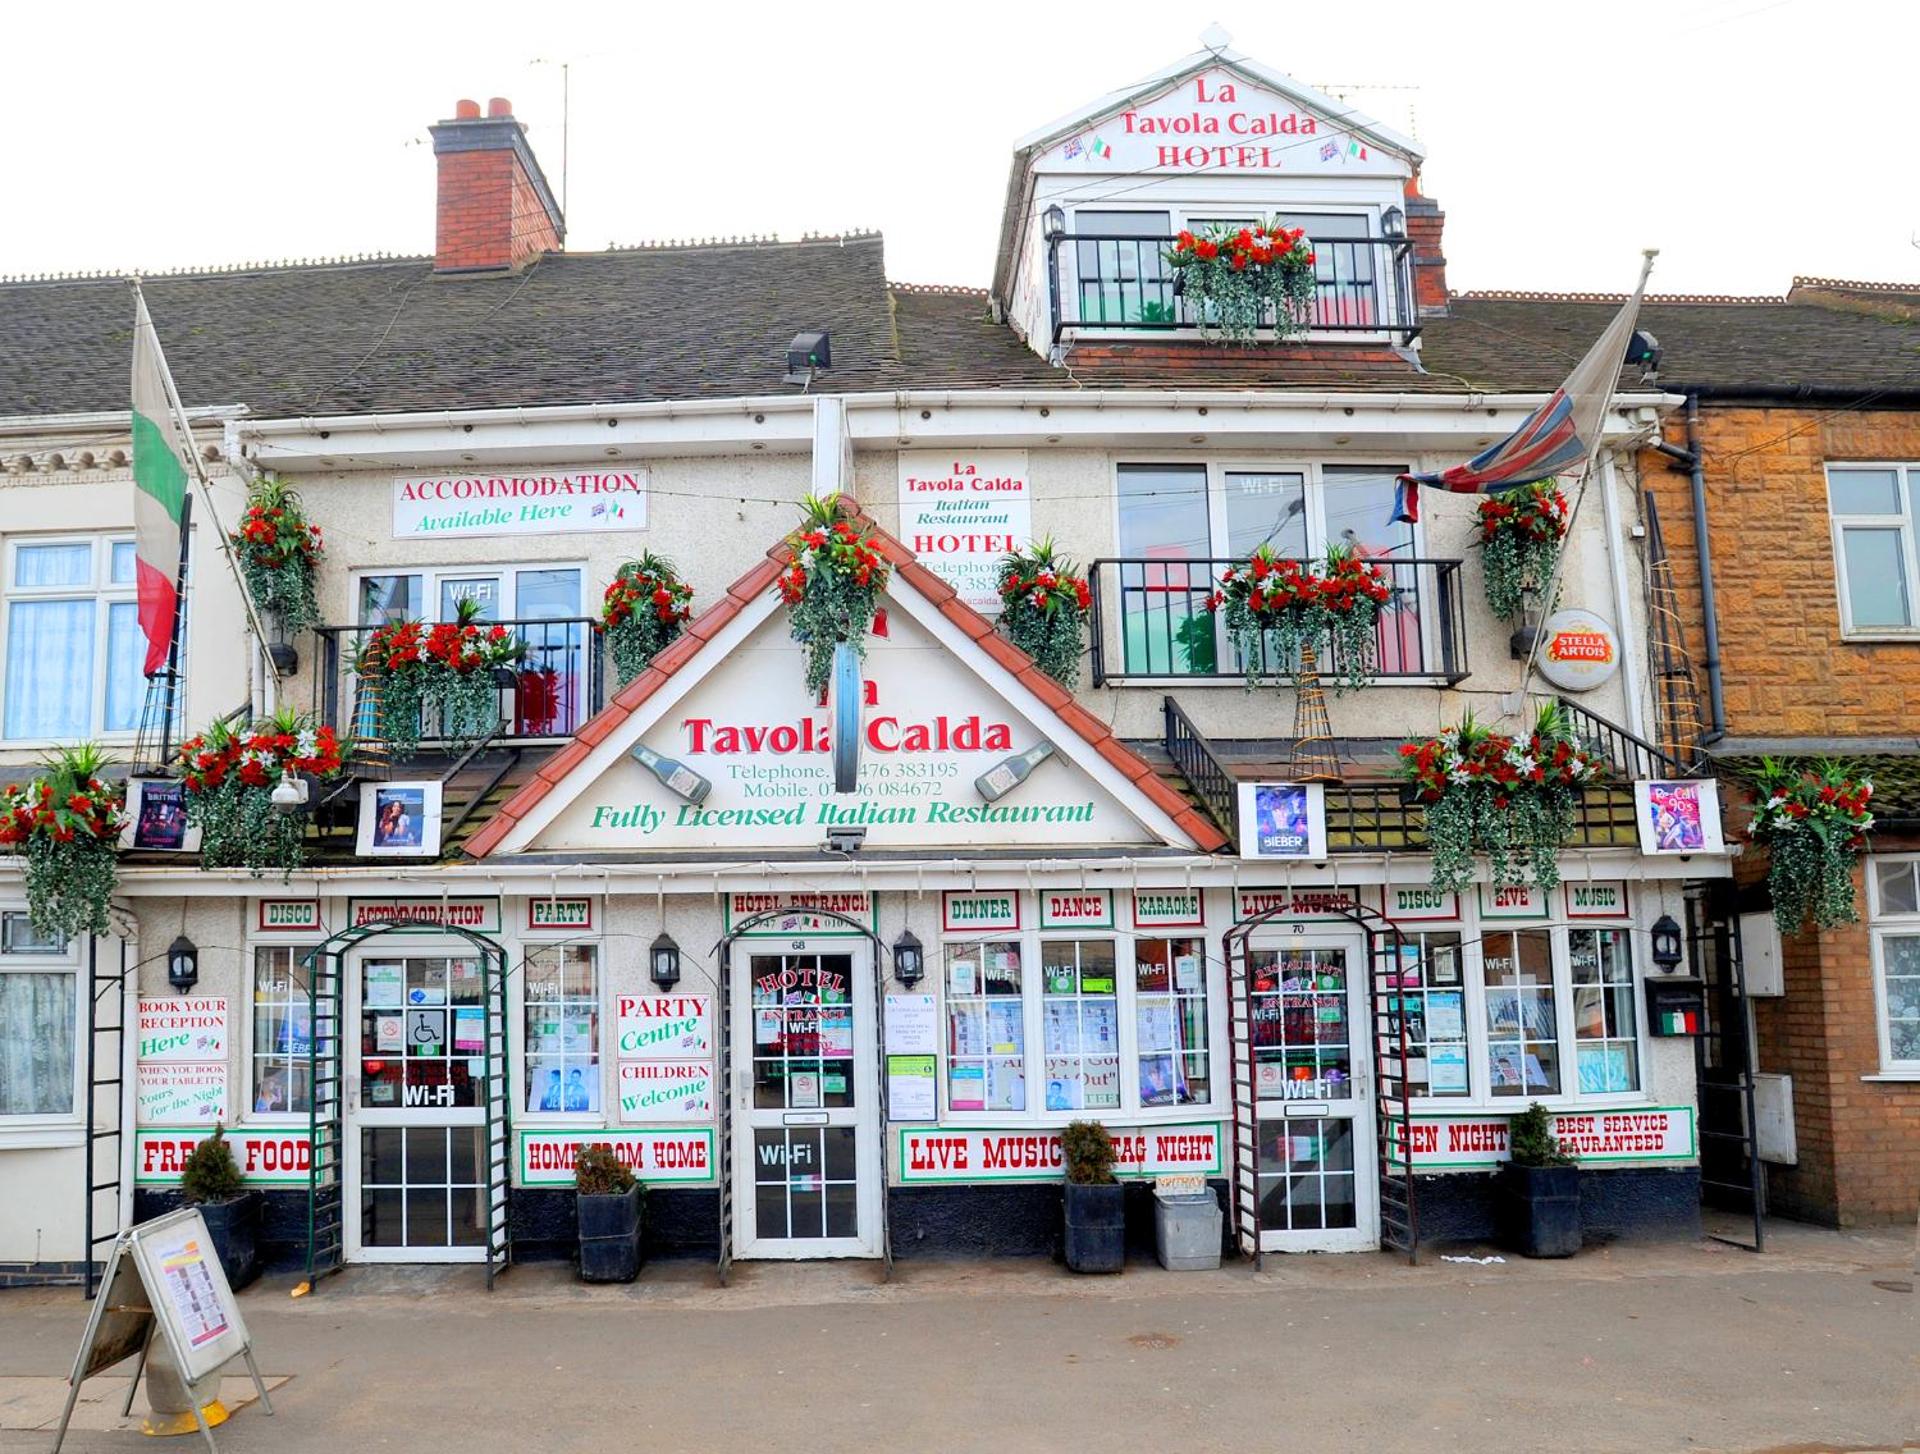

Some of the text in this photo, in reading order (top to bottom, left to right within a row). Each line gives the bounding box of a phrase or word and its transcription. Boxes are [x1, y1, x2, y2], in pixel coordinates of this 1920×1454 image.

[1196, 79, 1236, 103] La
[1120, 112, 1316, 135] Tavola Calda
[1157, 146, 1281, 168] HOTEL
[953, 462, 976, 475] La
[401, 474, 639, 501] ACCOMMODATION
[907, 478, 1022, 491] Tavola Calda
[936, 499, 990, 512] Italian
[415, 503, 573, 532] Available Here
[917, 514, 1008, 525] Restaurant
[914, 535, 1022, 553] HOTEL
[449, 583, 492, 601] Wi-Fi
[1560, 637, 1605, 647] STELLA
[1560, 647, 1605, 657] ARTOIS
[867, 715, 1010, 751] Calda
[728, 764, 830, 783] Telephone.
[895, 762, 959, 778] 383195
[744, 781, 813, 798] Mobile.
[879, 780, 942, 796] 084672
[593, 799, 1092, 832] Fully Licensed Italian Restaurant
[1264, 836, 1303, 847] BIEBER
[735, 895, 783, 912] HOTEL
[1138, 895, 1198, 914] KARAOKE
[1241, 894, 1283, 915] LIVE
[1397, 891, 1440, 910] DISCO
[1575, 886, 1616, 906] MUSIC
[270, 904, 313, 924] DISCO
[535, 903, 588, 921] PARTY
[951, 899, 1010, 917] DINNER
[1051, 896, 1102, 916] DANCE
[1293, 924, 1305, 934] 70
[792, 942, 806, 951] 68
[1485, 957, 1513, 971] Wi-Fi
[1571, 954, 1598, 967] Wi-Fi
[986, 969, 1015, 981] Wi-Fi
[1044, 966, 1075, 978] Wi-Fi
[1138, 964, 1166, 976] Wi-Fi
[259, 980, 288, 993] Wi-Fi
[529, 982, 559, 995] Wi-Fi
[758, 967, 846, 995] HOTEL
[139, 999, 226, 1014] BOOK YOUR
[620, 998, 707, 1017] PARTY
[1262, 996, 1340, 1009] ENTRANCE
[140, 1016, 224, 1030] RECEPTION
[762, 1009, 845, 1023] ENTRANCE
[1252, 1008, 1280, 1020] Wi-Fi
[619, 1017, 698, 1053] Centre
[789, 1021, 820, 1034] Wi-Fi
[140, 1033, 191, 1058] Here
[138, 1065, 225, 1075] WHEN YOU BOOK
[622, 1065, 709, 1080] CHILDREN
[403, 1084, 456, 1106] Wi-Fi
[620, 1081, 706, 1113] Welcome
[1283, 1079, 1331, 1100] Wi-Fi
[1556, 1114, 1669, 1134] BEST SERVICE
[1448, 1123, 1508, 1152] NIGHT
[1559, 1134, 1664, 1154] GAURANTEED
[144, 1140, 314, 1172] FRE FOOD
[653, 1141, 706, 1168] HOME
[760, 1143, 812, 1166] Wi-Fi
[911, 1135, 1214, 1169] LIVE MUSIC TAG NIGHT
